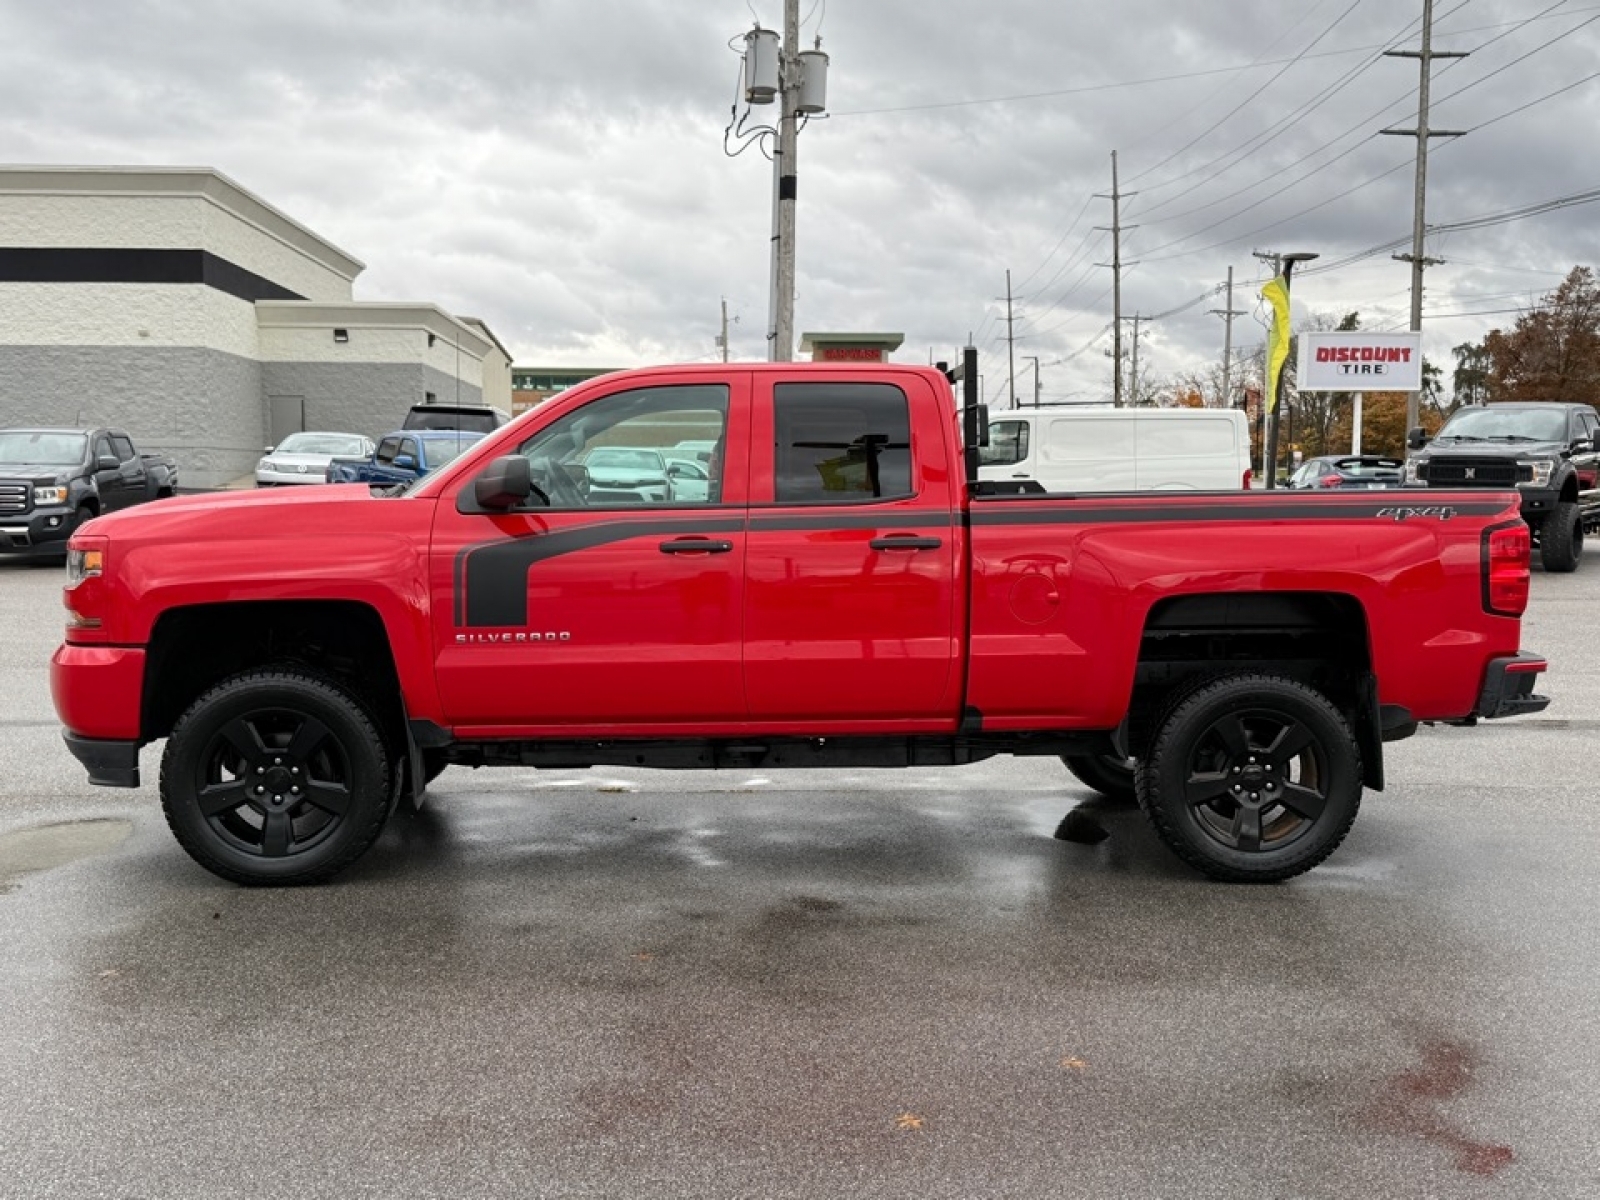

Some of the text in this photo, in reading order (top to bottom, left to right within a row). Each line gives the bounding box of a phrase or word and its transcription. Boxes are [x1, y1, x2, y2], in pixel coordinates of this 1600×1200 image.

[1316, 347, 1411, 362] DISCOUNT
[1342, 364, 1383, 374] TIRE
[455, 632, 571, 643] SILVERADO
